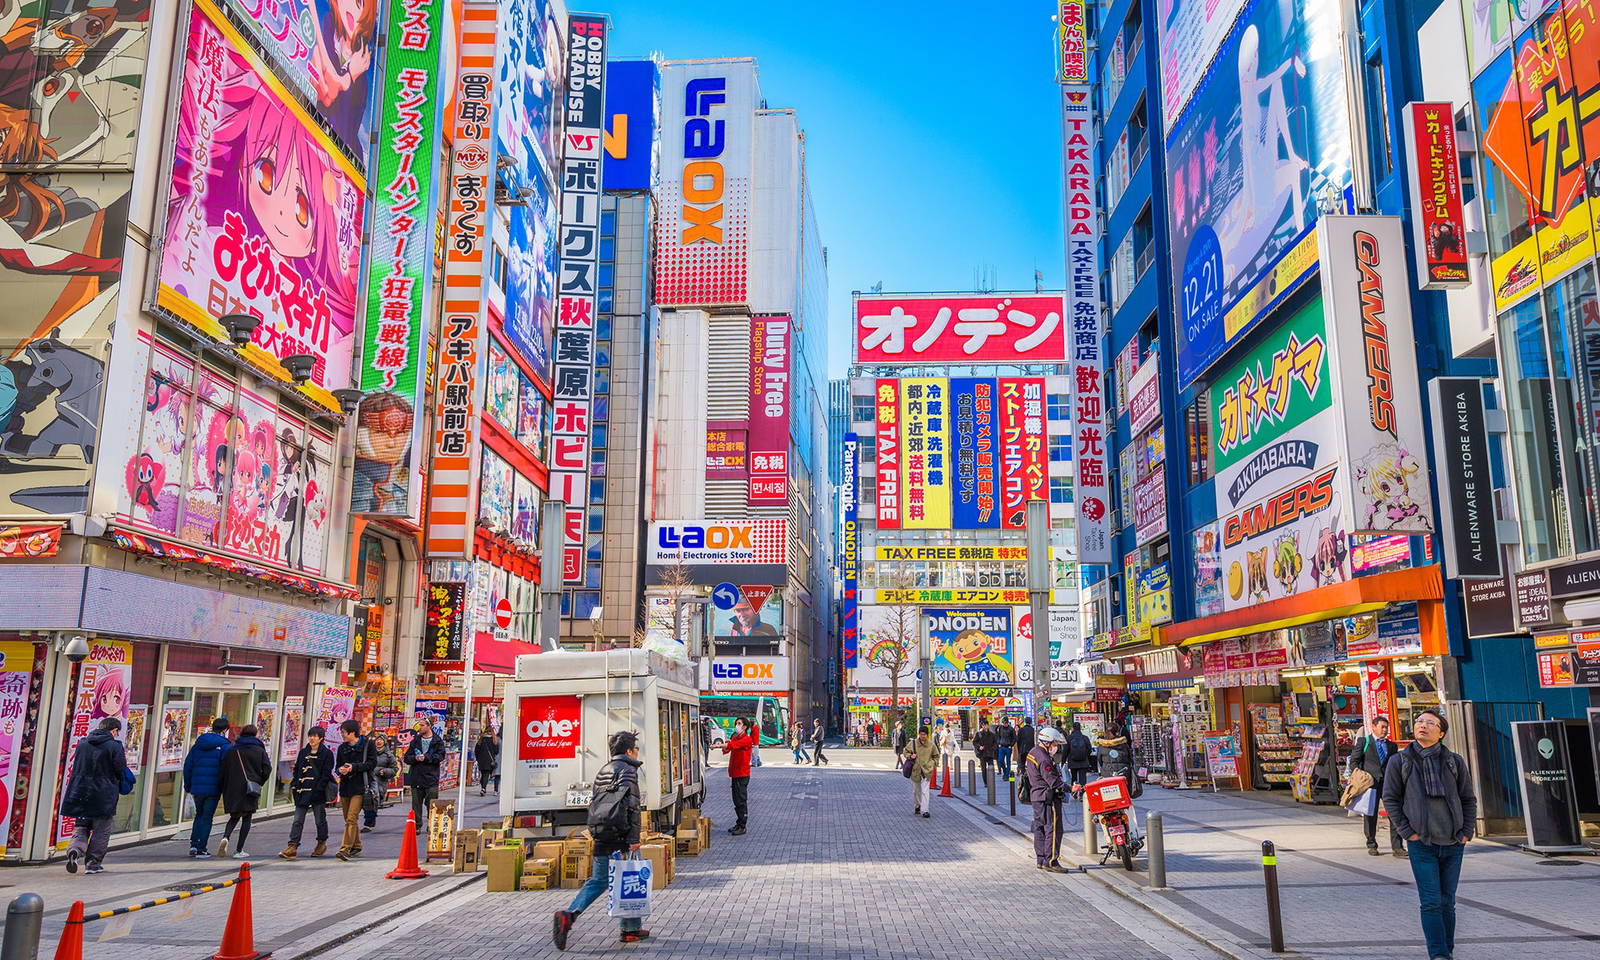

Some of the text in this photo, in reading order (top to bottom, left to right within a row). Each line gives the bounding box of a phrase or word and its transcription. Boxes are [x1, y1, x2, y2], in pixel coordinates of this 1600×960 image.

[587, 23, 603, 90] HOBBY
[1062, 3, 1085, 78] まんが喫茶
[568, 21, 586, 122] PARADISE
[460, 74, 489, 141] 買取り
[1067, 119, 1092, 235] TAKARADA
[1426, 122, 1449, 218] カードキングダム
[456, 175, 486, 255] まっくす
[1071, 241, 1094, 298] TAX-FREE
[1184, 253, 1218, 321] 12.21
[861, 298, 1060, 354] オノデン
[1074, 301, 1097, 360] 免税商店
[1188, 302, 1219, 342] ON SALE
[1353, 230, 1398, 441] GAMERS
[441, 316, 475, 455] アキバ駅前店
[753, 321, 765, 395] Flagship Store
[764, 321, 788, 417] Duty Free
[707, 432, 726, 441] 本店
[754, 456, 784, 469] 免税
[878, 384, 897, 520] 免税 TAX FREE
[958, 394, 974, 503] お見積り無料です
[753, 482, 785, 493] 면세점
[844, 441, 856, 512] Panasonic
[1236, 443, 1306, 494] AKIHABARA
[1456, 392, 1482, 561] ALIENWARE STORE AKIBA
[1224, 468, 1338, 549] GAMERS
[683, 551, 728, 560] Electronics
[730, 551, 753, 559] Store
[845, 521, 856, 579] ONODEN
[883, 548, 914, 559] TAX
[917, 548, 956, 559] FREE
[960, 548, 994, 559] 免税店
[884, 591, 1030, 601] テレビ 冷蔵庫 エアコン 特売
[1470, 580, 1505, 591] ALIENWARE
[1471, 591, 1505, 602] STORE AKIBA
[929, 617, 1007, 631] ONODEN
[1060, 632, 1078, 640] Shop
[934, 670, 1008, 682] KIHABARA
[934, 688, 1011, 696] Kテレビはオノデンで!
[938, 697, 997, 705] オノデン
[623, 874, 647, 896] 売る
